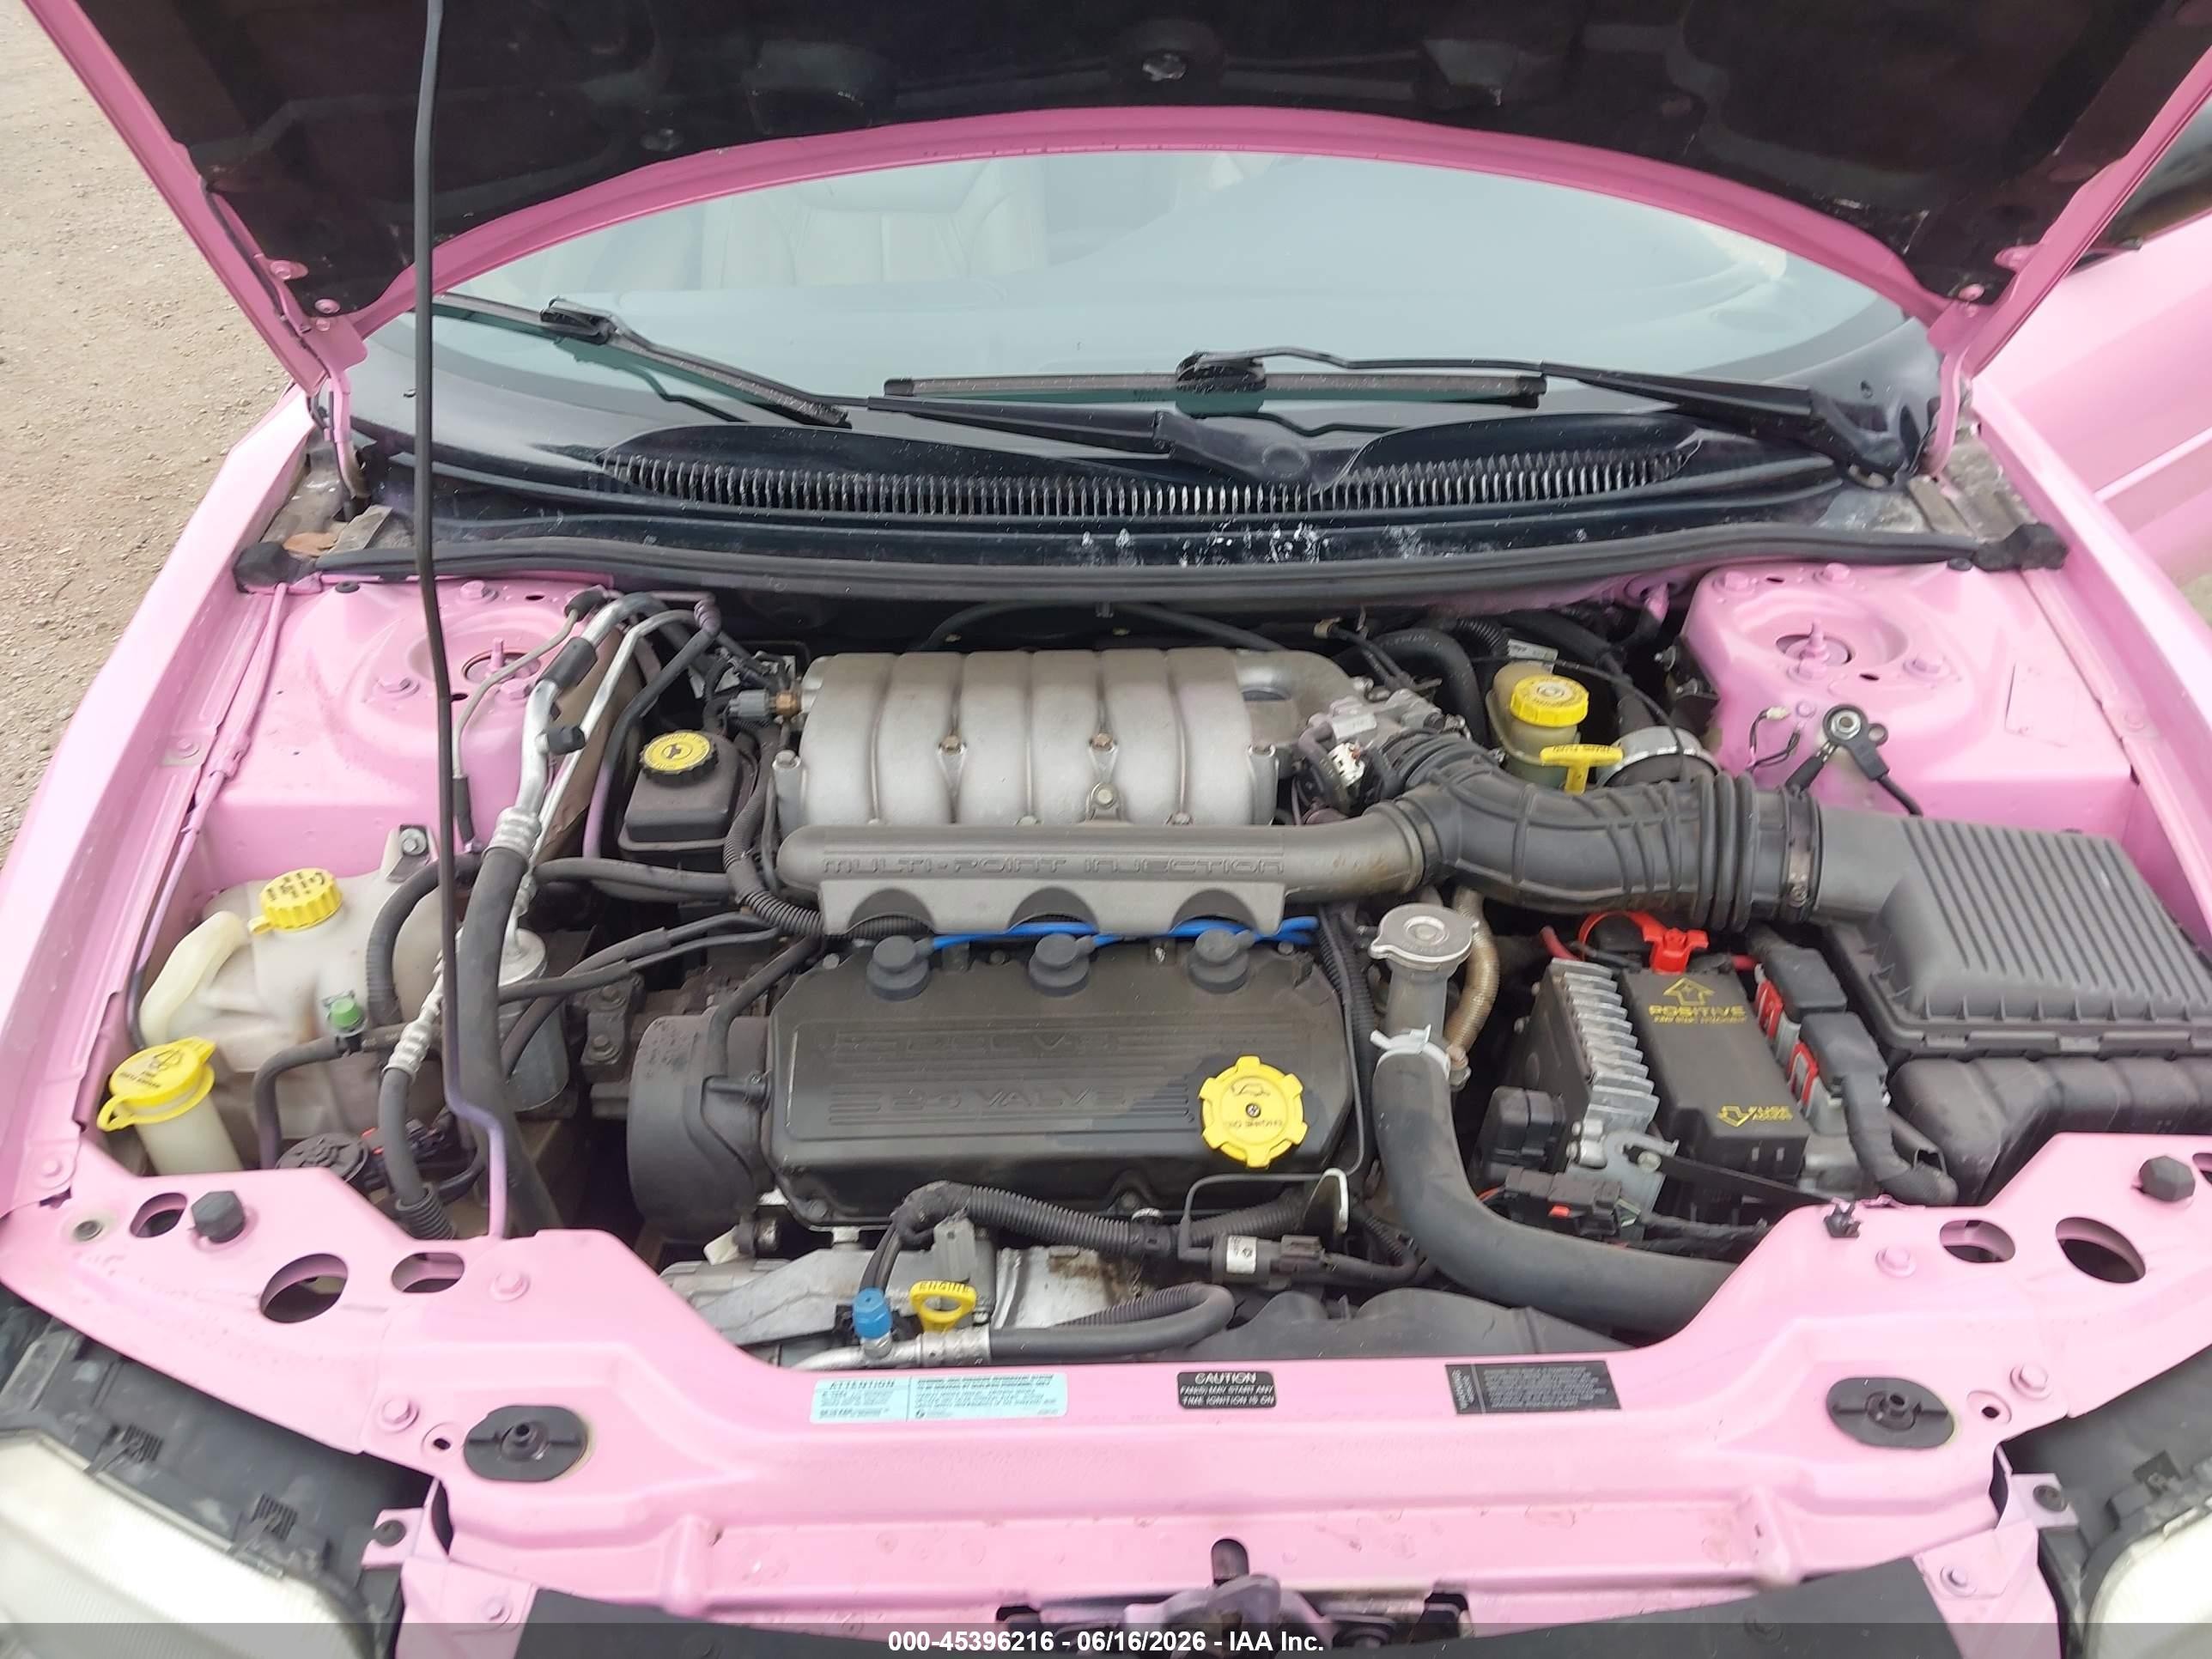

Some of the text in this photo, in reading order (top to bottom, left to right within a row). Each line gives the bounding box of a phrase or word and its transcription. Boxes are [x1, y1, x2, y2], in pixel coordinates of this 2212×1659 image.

[1085, 857, 1285, 874] INJECTION
[1648, 1005, 1747, 1017] POSITIVE
[975, 1083, 1128, 1110] VALVE
[919, 1281, 970, 1292] ENGINE
[1194, 1372, 1257, 1384] CAUTION
[830, 1380, 896, 1390] ATTENTION
[1228, 1385, 1256, 1395] START
[1206, 1395, 1249, 1405] IGNITION
[1260, 1395, 1275, 1405] ON
